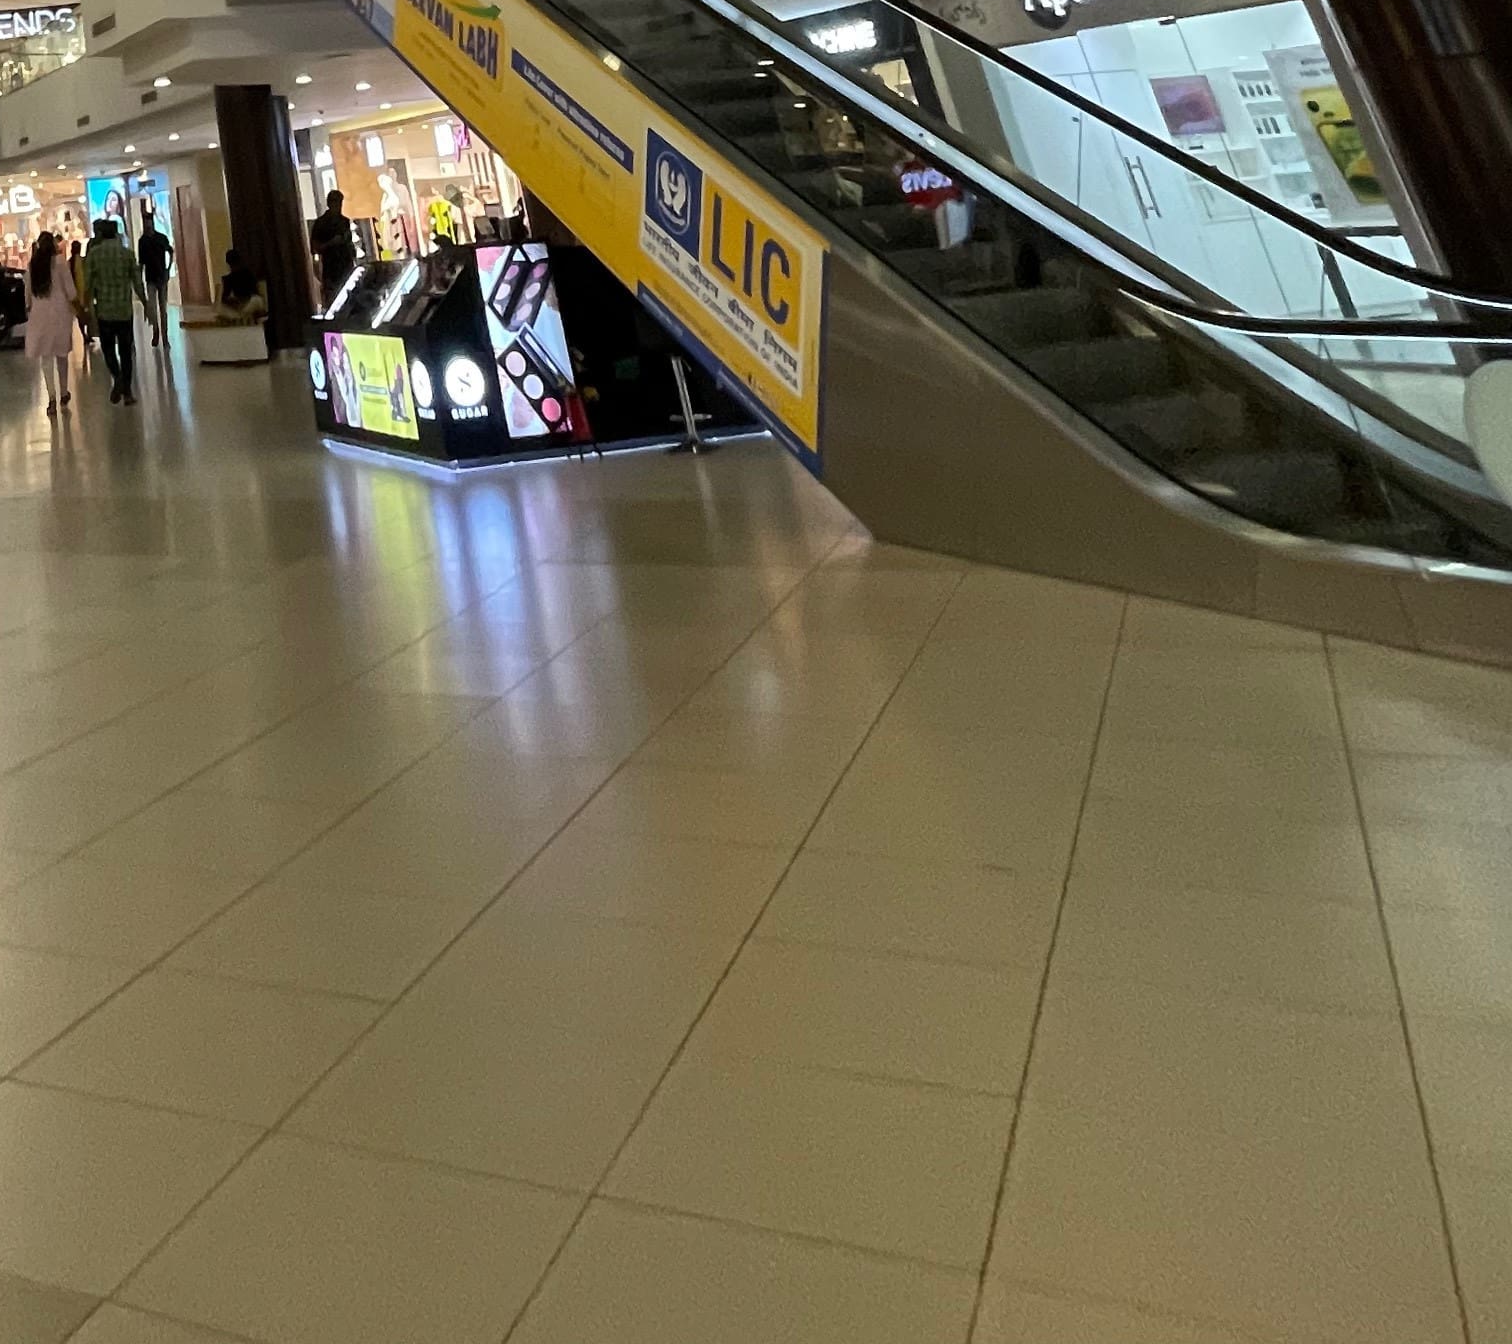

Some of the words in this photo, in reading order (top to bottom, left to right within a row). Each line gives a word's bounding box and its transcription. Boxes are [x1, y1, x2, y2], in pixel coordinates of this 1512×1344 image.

[458, 20, 499, 80] LABH
[711, 192, 790, 325] LIC
[450, 405, 489, 421] SUGAR
